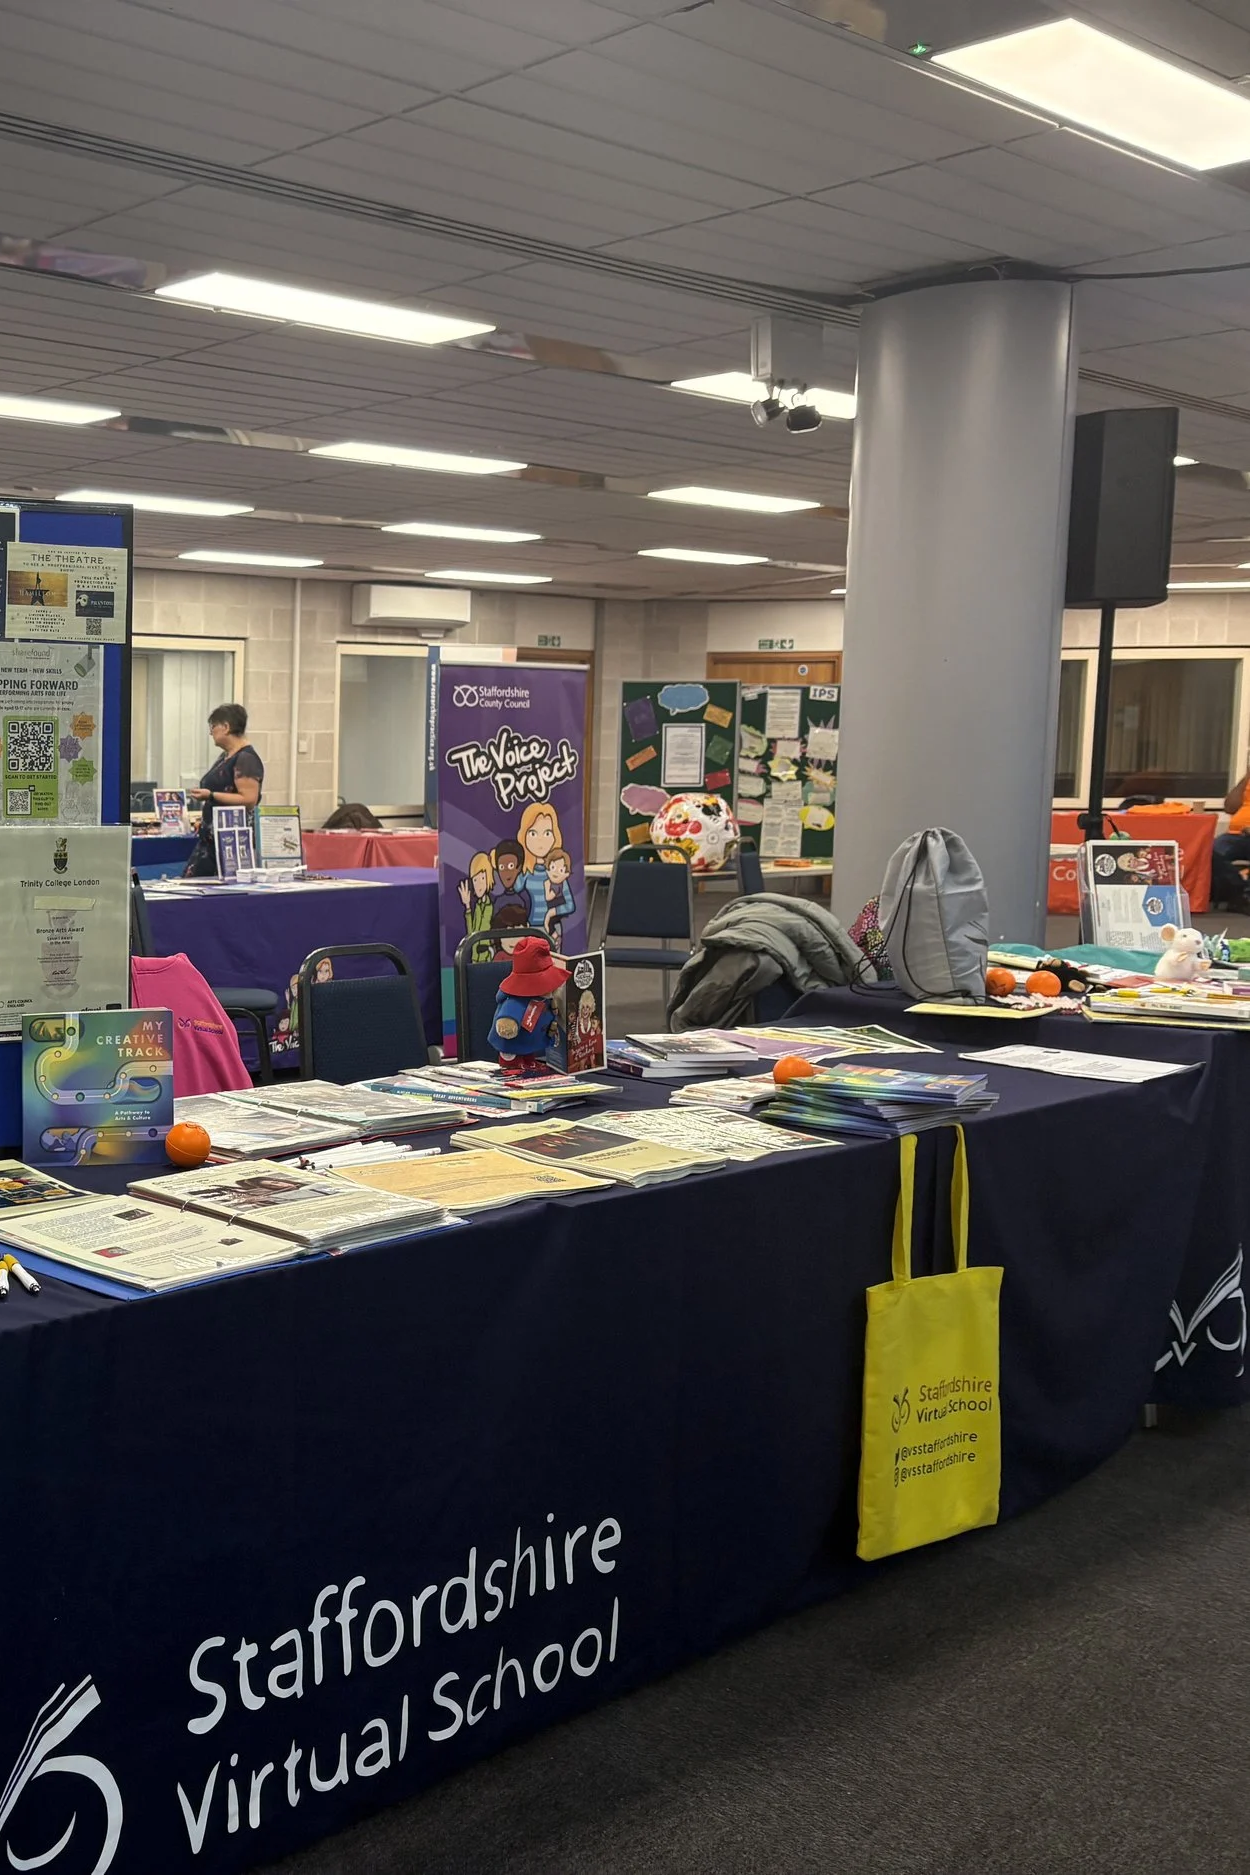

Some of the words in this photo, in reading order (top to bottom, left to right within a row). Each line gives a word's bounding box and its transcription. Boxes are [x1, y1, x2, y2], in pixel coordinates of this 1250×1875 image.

[31, 554, 51, 562] THE
[55, 555, 104, 564] THEATRE
[30, 680, 78, 690] FORWARD
[479, 686, 529, 698] Staffordshire
[812, 688, 835, 699] IPS
[479, 699, 502, 710] County
[504, 699, 530, 708] Council
[451, 748, 492, 779] The
[490, 732, 546, 769] Voice
[495, 745, 574, 805] Project
[20, 880, 43, 888] Trinity
[45, 879, 72, 887] College
[73, 878, 100, 886] London
[142, 1021, 163, 1031] MY
[96, 1034, 163, 1045] CREATIVE
[118, 1047, 163, 1057] TRACK
[917, 1407, 947, 1424] Virtua
[948, 1397, 992, 1413] School
[187, 1512, 623, 1735] Staffordshire
[175, 1694, 412, 1856] Virtual
[427, 1596, 620, 1743] School
